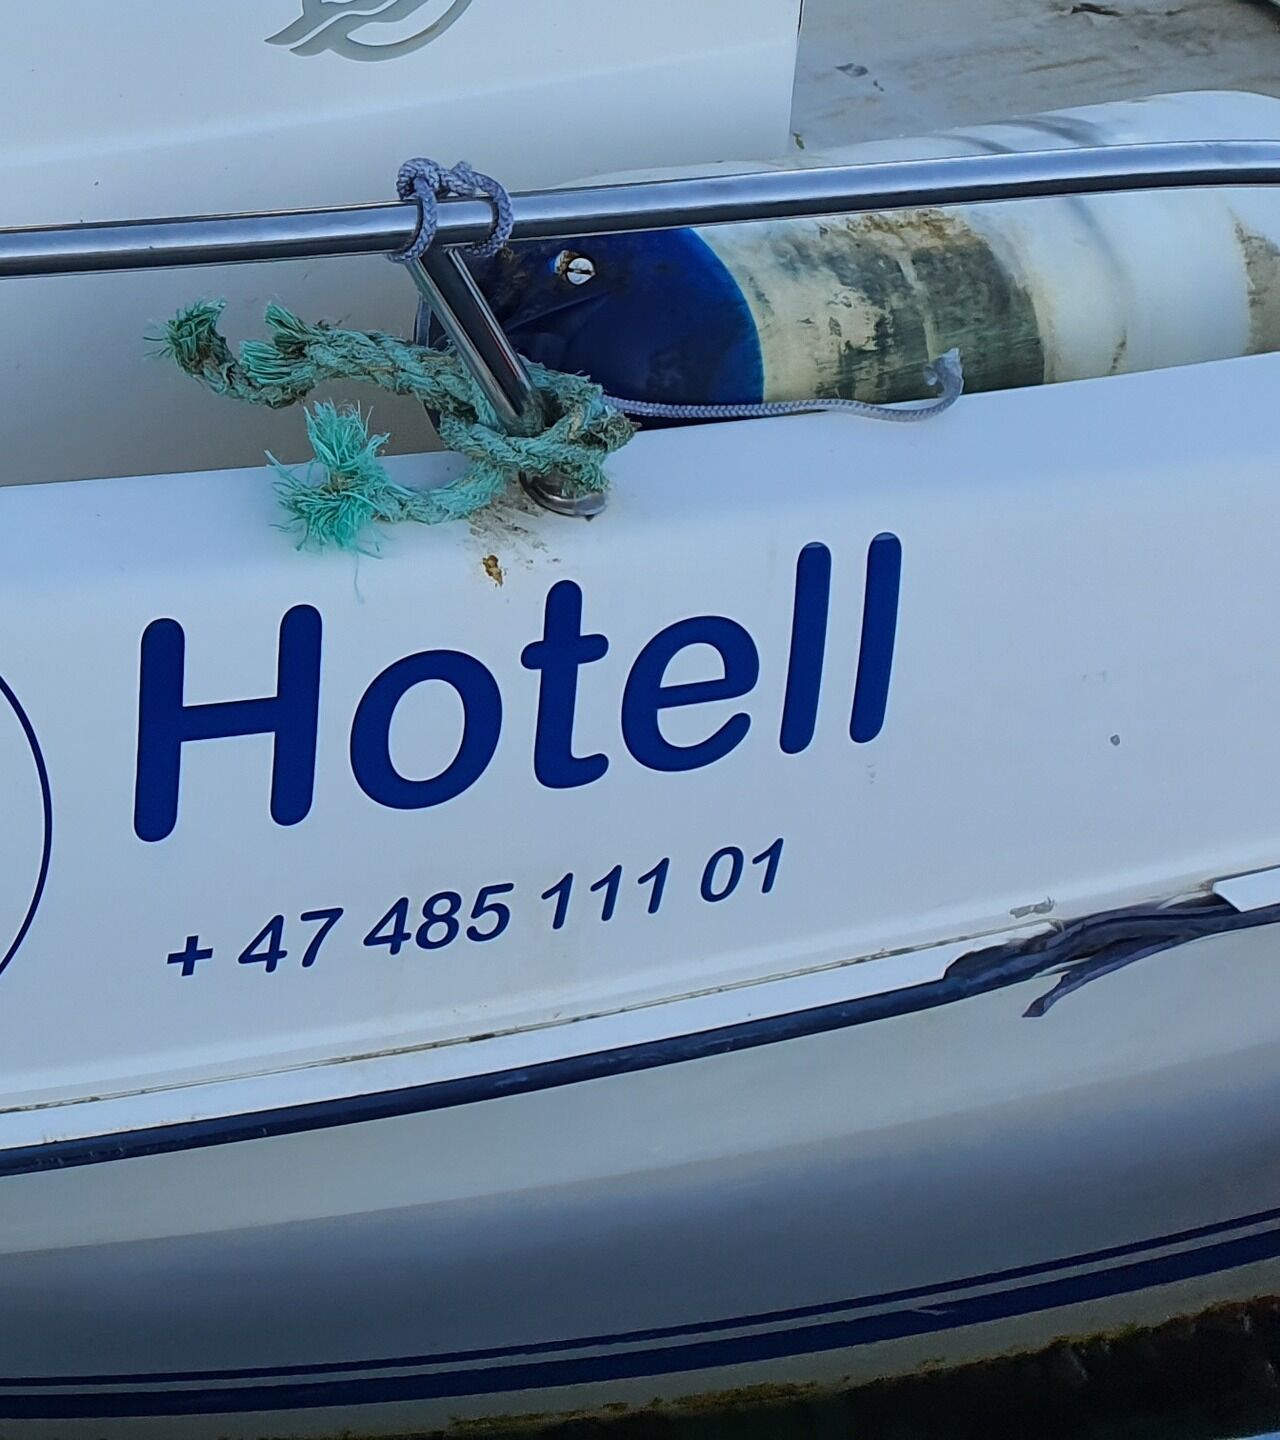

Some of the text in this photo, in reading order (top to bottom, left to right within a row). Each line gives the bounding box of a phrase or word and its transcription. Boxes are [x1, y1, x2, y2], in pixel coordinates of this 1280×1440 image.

[132, 530, 906, 845] Hotell
[167, 836, 785, 978] + 47 485 111 01
